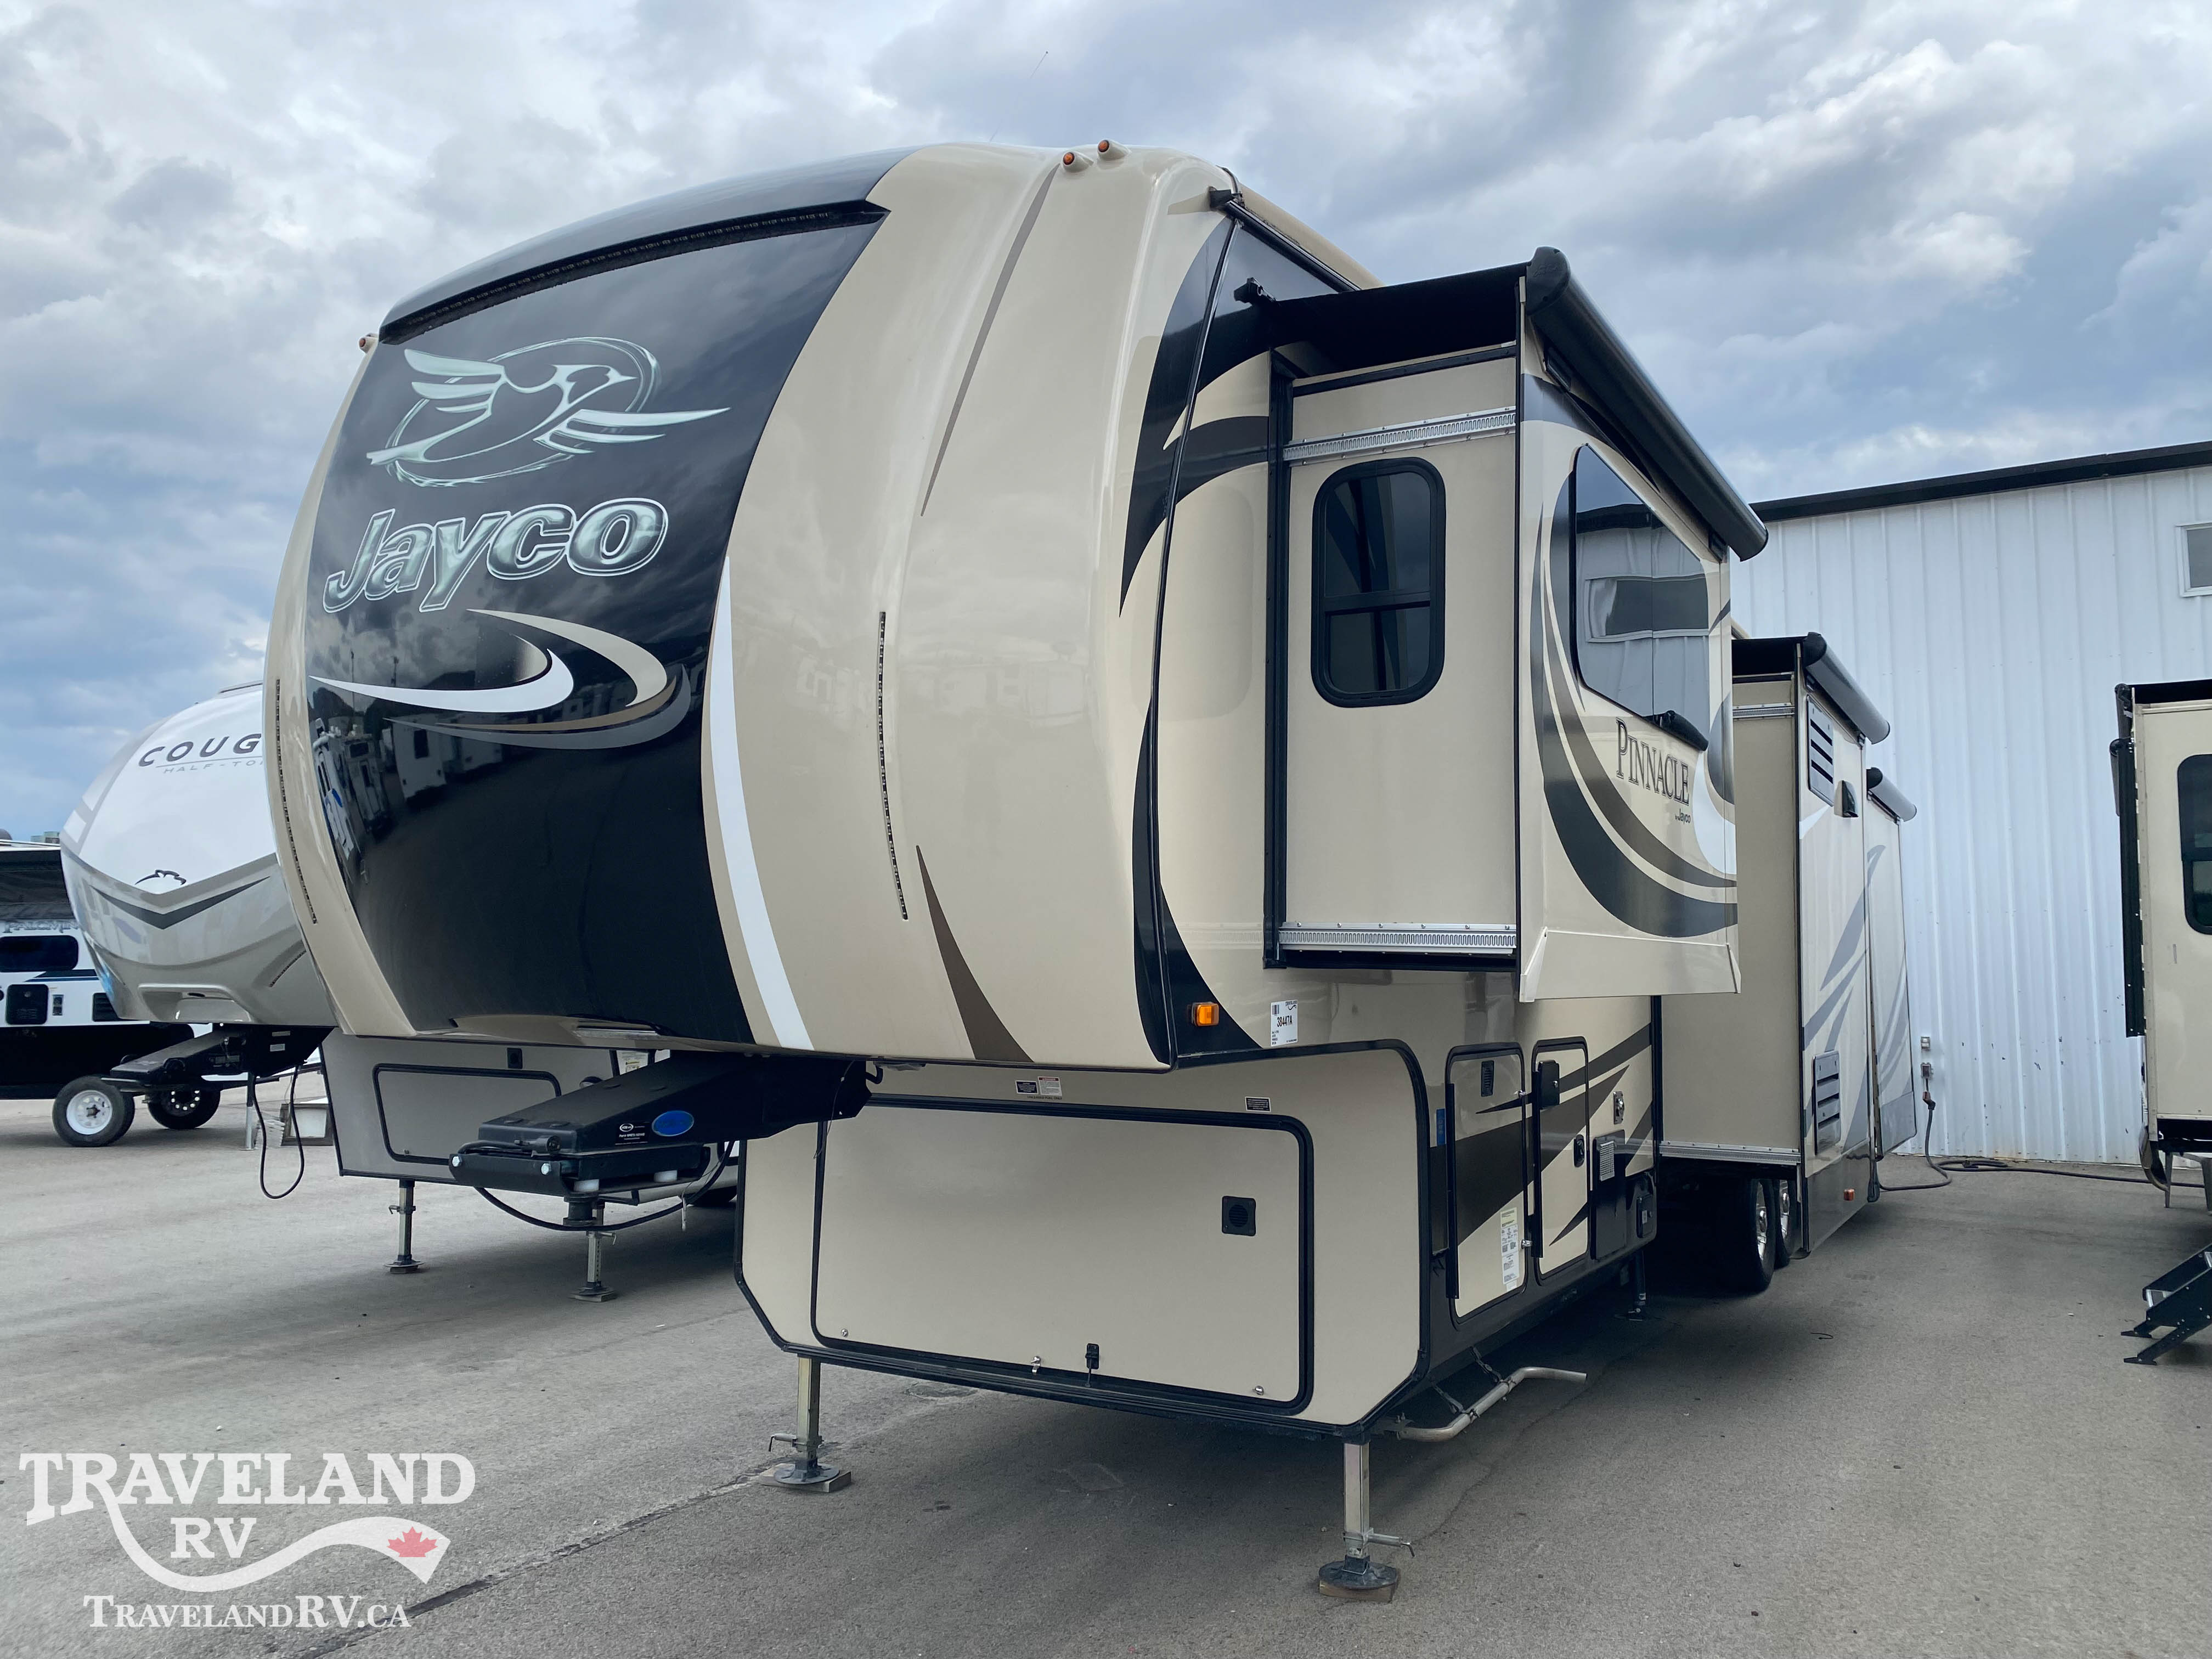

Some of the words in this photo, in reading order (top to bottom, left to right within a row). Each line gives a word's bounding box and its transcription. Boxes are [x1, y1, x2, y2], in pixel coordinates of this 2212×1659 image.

[322, 497, 669, 613] Jayco
[163, 760, 263, 774] HALF-TO
[1616, 716, 1690, 806] PINNACLE
